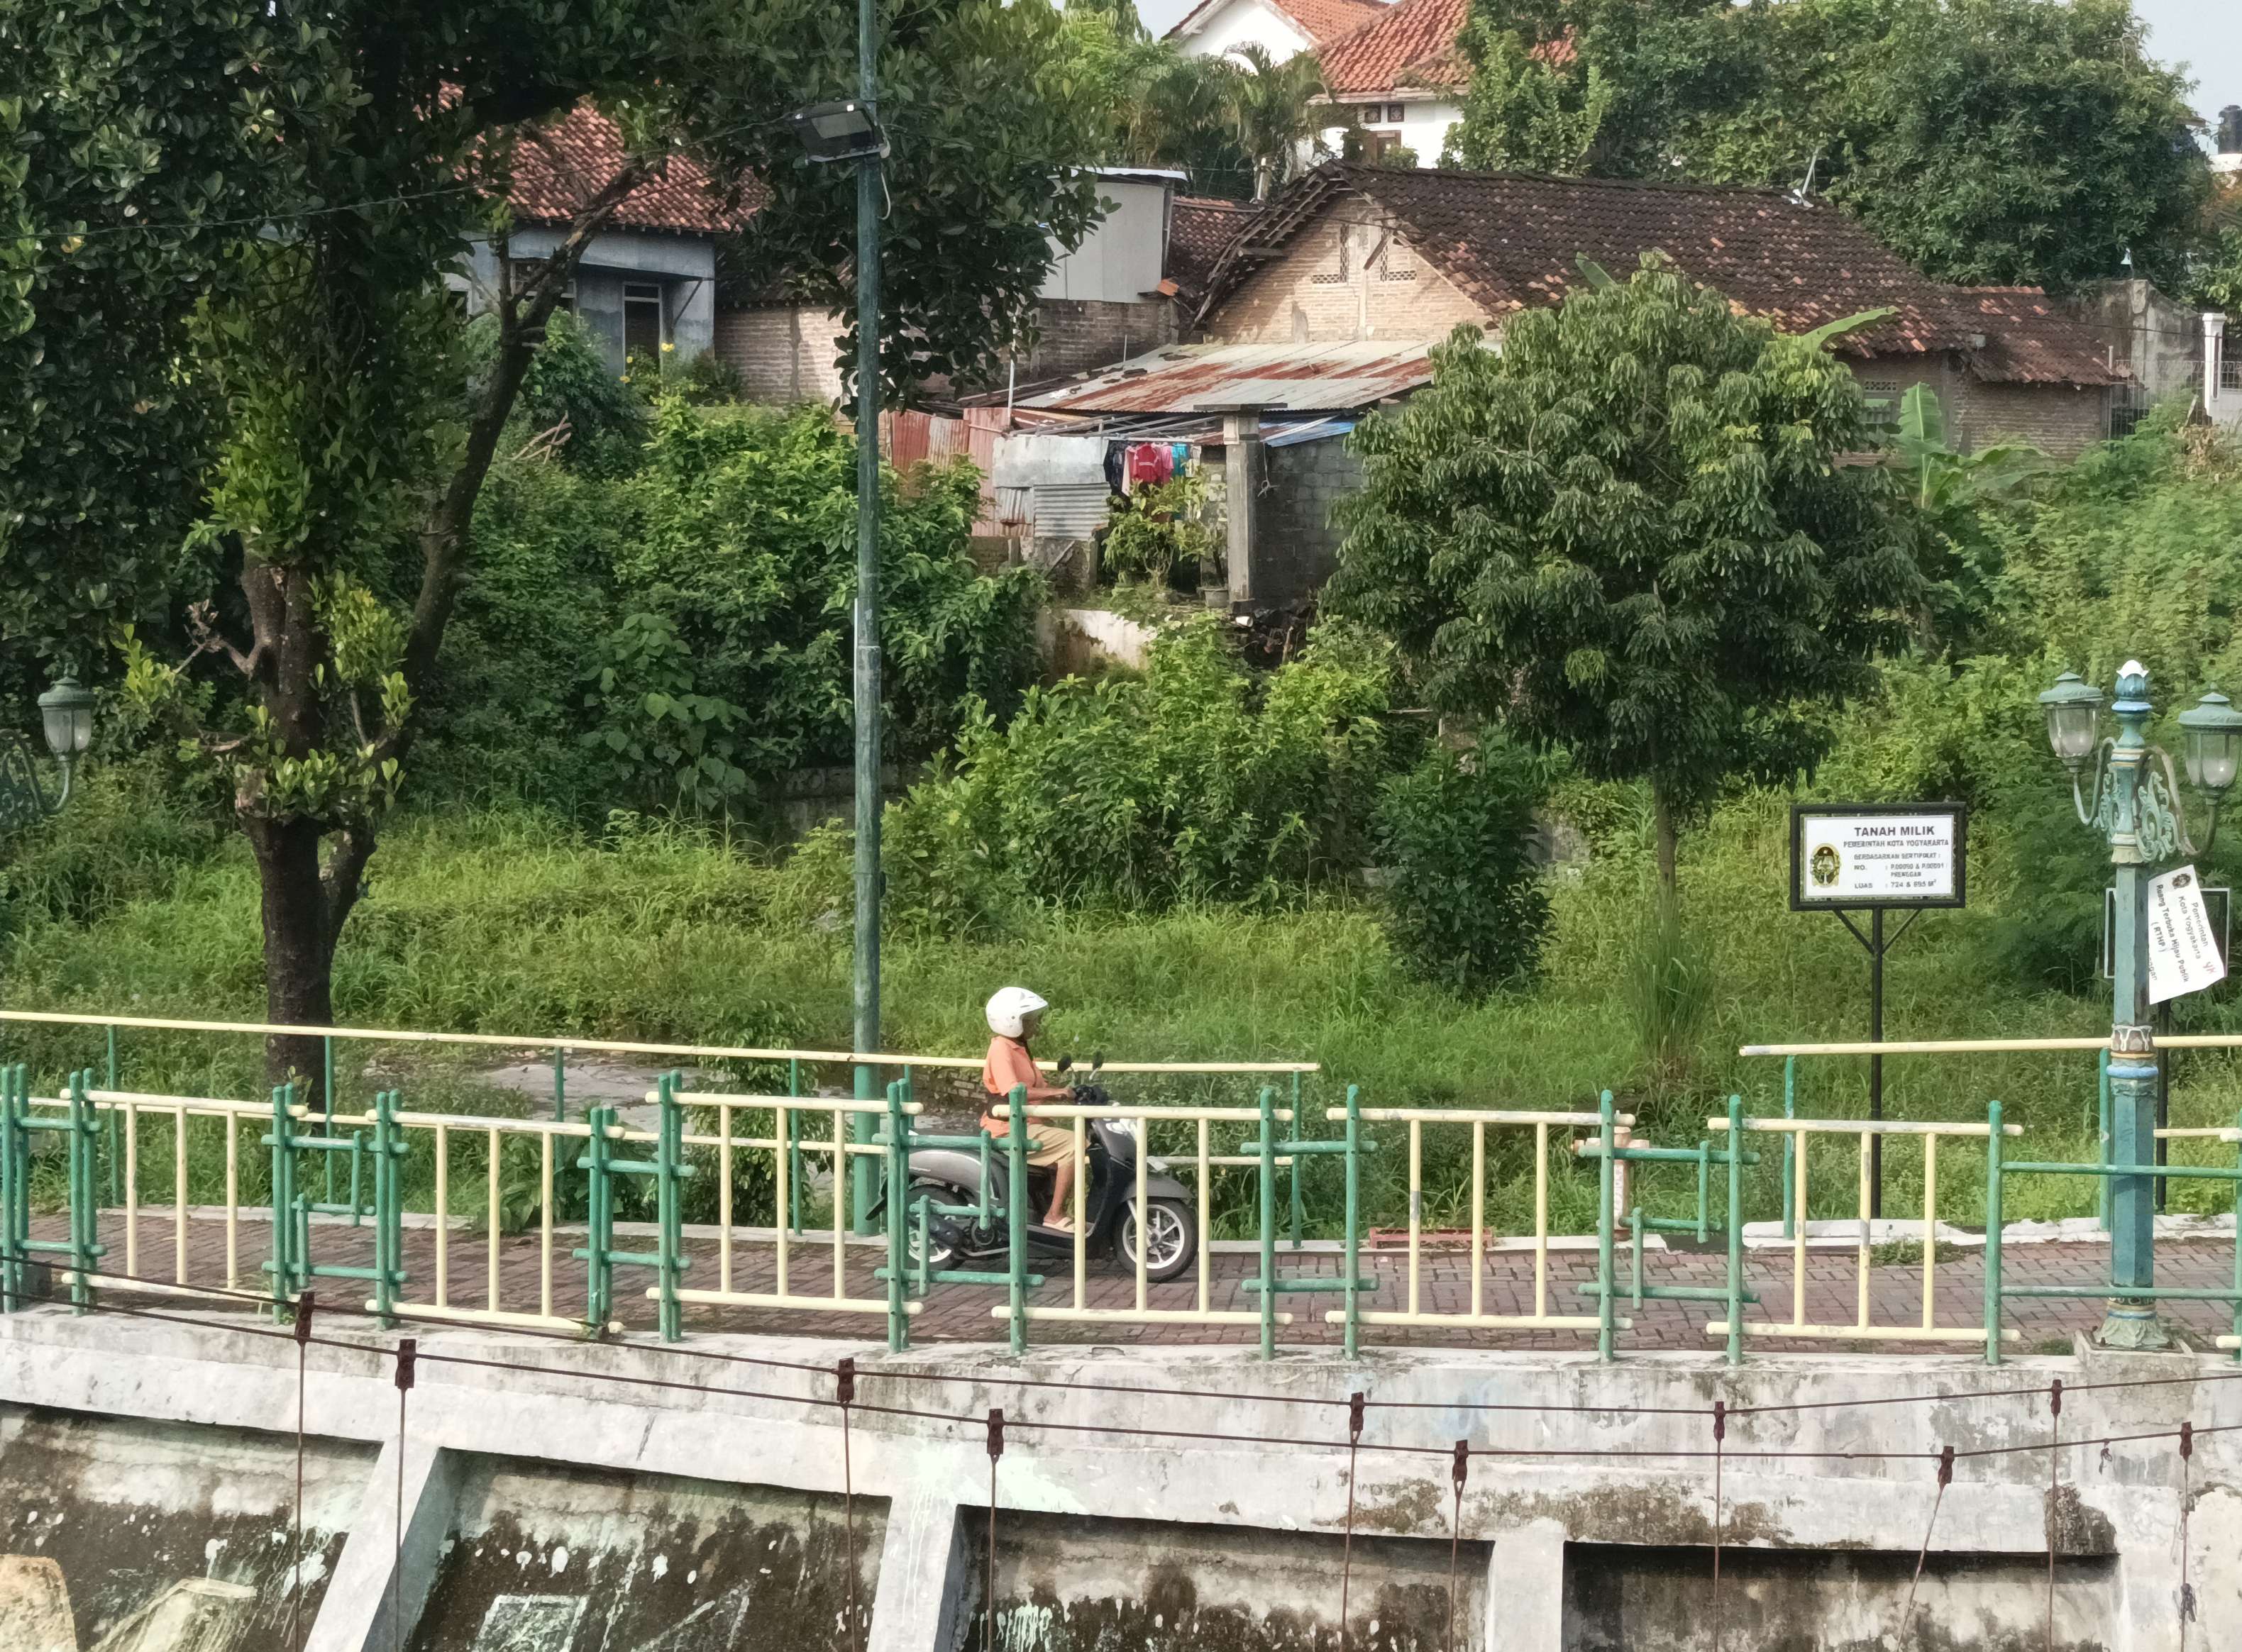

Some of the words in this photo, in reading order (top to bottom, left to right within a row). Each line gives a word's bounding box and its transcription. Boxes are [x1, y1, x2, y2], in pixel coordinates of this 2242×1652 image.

[1854, 826, 1896, 836] TANAH
[1900, 826, 1935, 836] MILIK
[2156, 884, 2166, 907] Ruang
[2163, 907, 2175, 938] Terbuka
[2178, 896, 2187, 914] Kota
